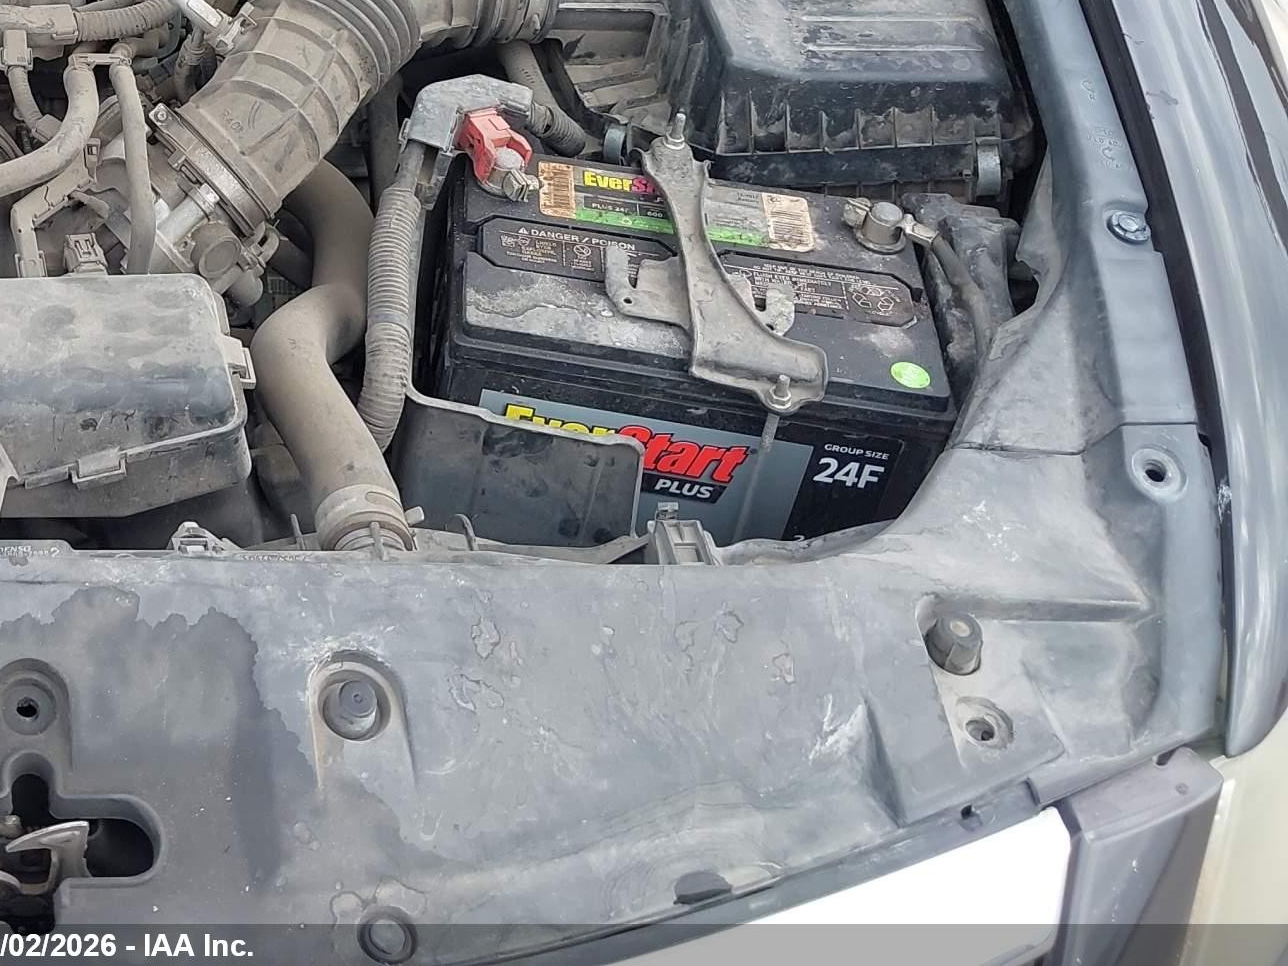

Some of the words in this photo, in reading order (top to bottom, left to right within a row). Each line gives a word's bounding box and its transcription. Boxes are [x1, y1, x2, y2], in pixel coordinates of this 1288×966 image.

[646, 210, 664, 219] 600
[531, 228, 581, 243] DANGER
[591, 238, 637, 252] POISON
[824, 443, 865, 456] GROUP
[864, 450, 891, 460] SIZE
[813, 457, 886, 490] 24F
[654, 479, 714, 500] PLUS
